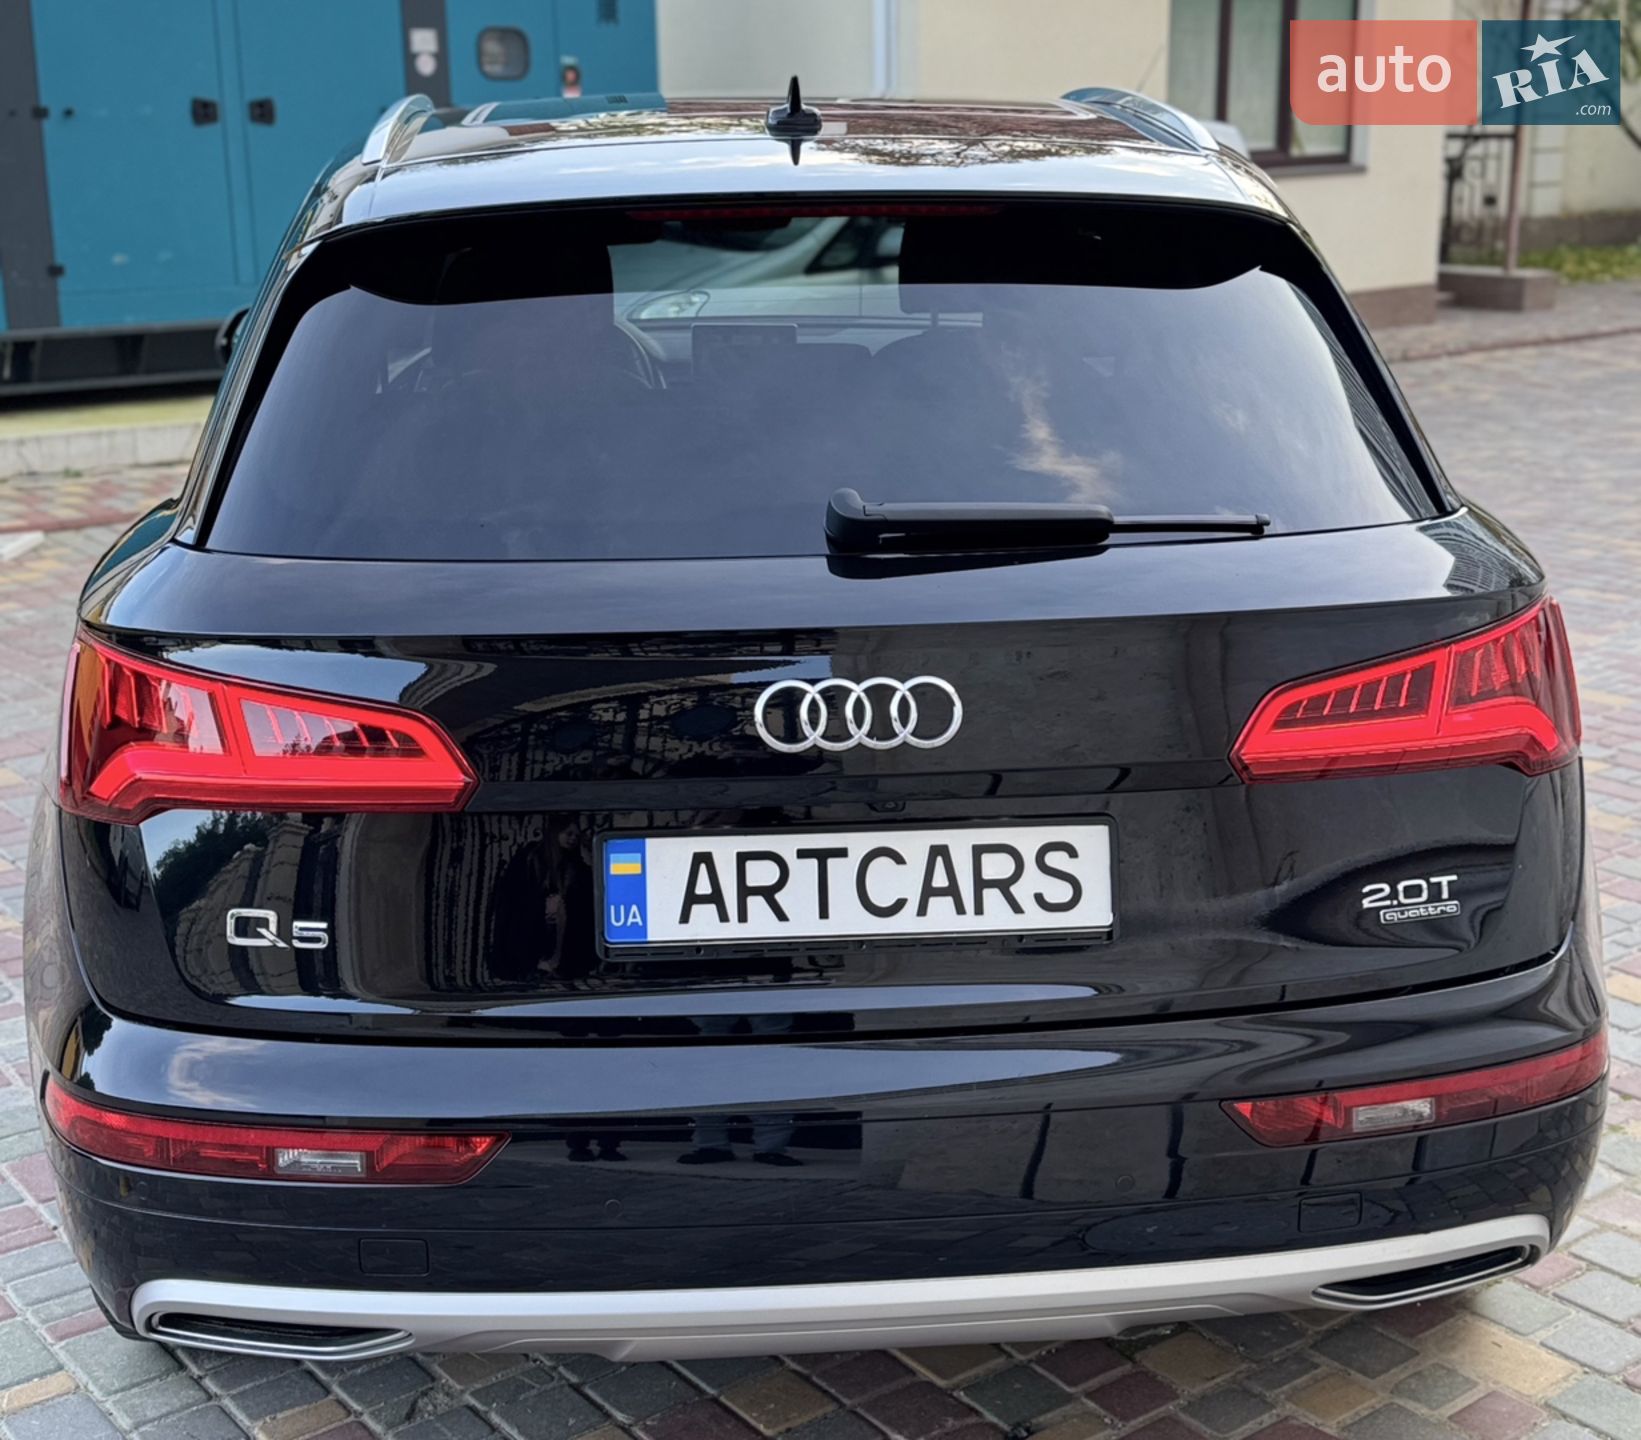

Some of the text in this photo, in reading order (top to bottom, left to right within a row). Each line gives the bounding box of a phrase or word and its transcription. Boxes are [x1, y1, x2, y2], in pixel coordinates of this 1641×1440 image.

[678, 841, 1083, 925] ARTCARS
[1361, 874, 1458, 909] 2.0T
[226, 908, 329, 951] Q5
[610, 904, 643, 927] UA
[1384, 904, 1458, 922] quattro
